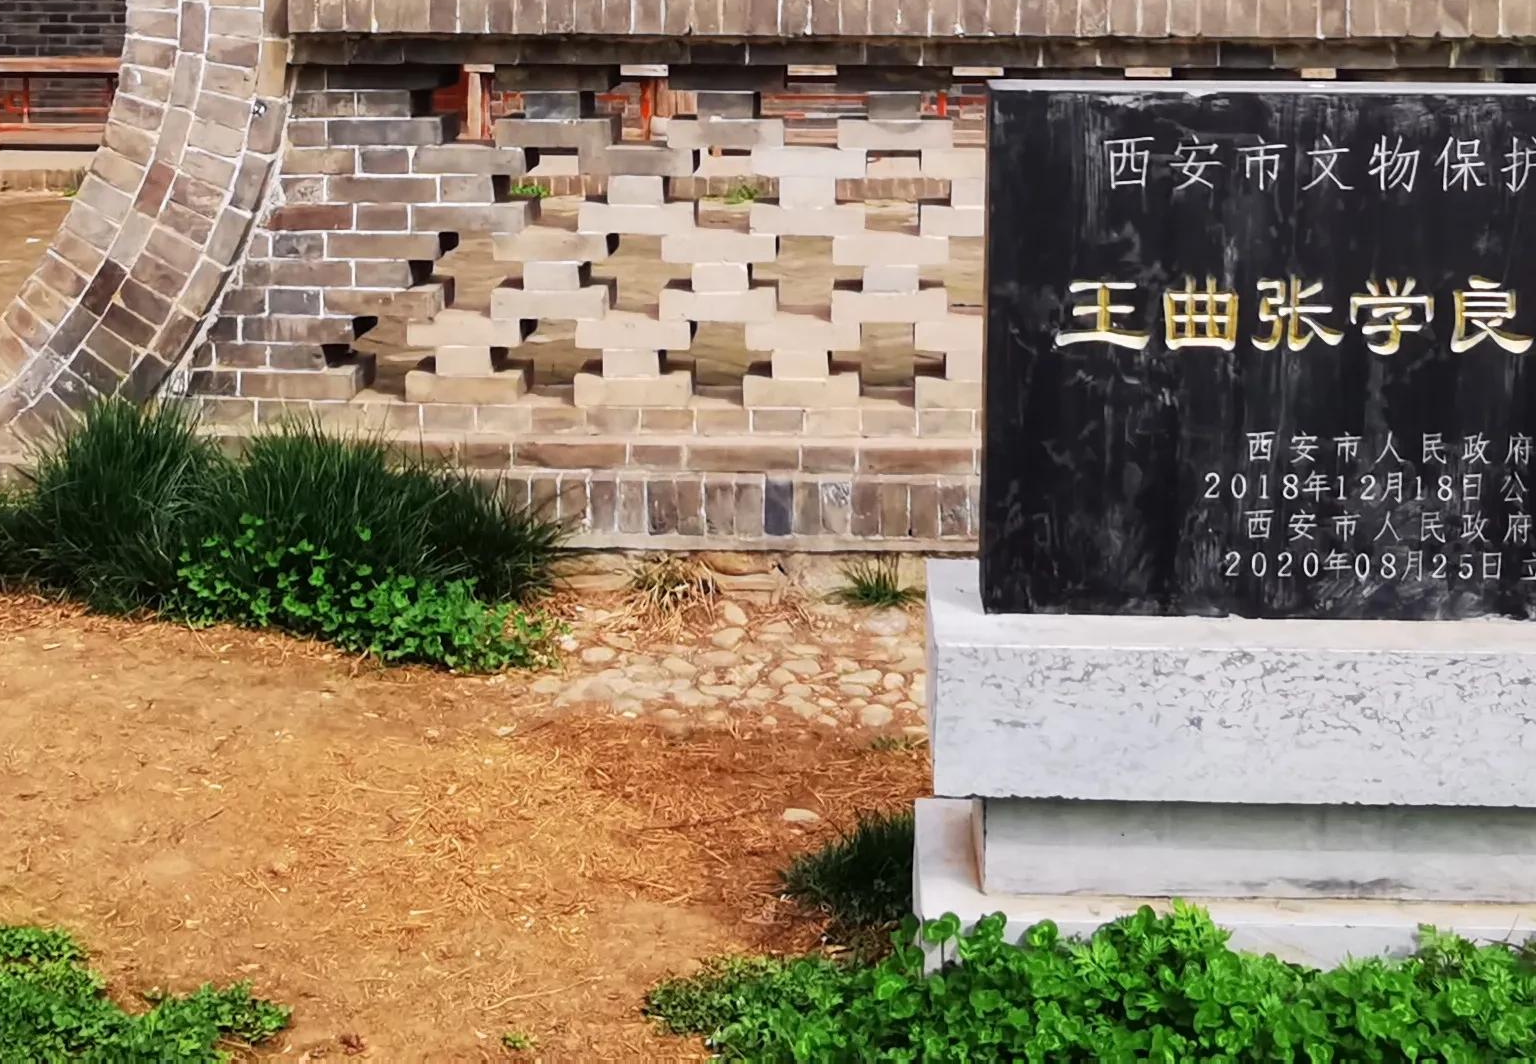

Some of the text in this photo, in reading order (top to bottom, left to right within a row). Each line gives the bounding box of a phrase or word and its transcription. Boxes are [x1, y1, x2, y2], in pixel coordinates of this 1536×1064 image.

[1245, 430, 1533, 464] 西安市人民政府
[1245, 509, 1533, 543] 西安市人民政府
